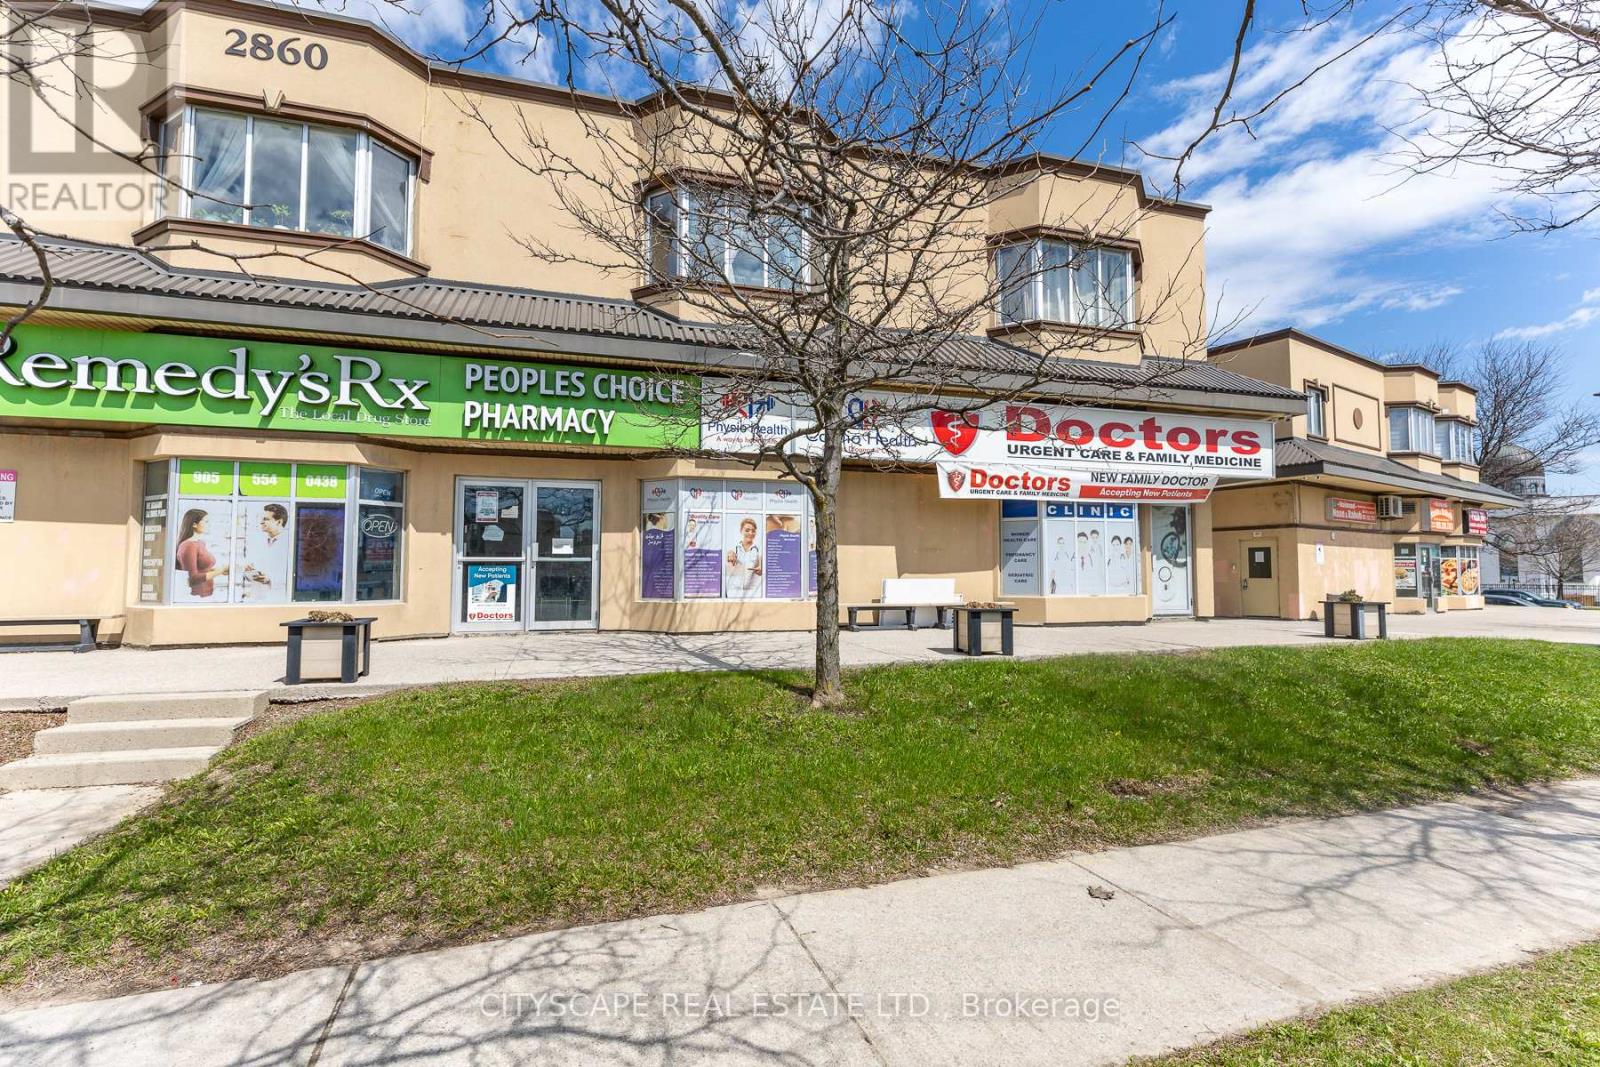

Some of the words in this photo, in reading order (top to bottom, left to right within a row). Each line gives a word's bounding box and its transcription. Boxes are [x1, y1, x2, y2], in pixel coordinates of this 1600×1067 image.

[225, 28, 328, 70] 2860
[465, 363, 585, 397] PEOPLES
[593, 374, 684, 404] CHOICE
[280, 407, 307, 419] The
[313, 409, 350, 421] Local
[357, 411, 390, 428] Drug
[395, 413, 432, 426] Store
[464, 401, 615, 434] PHARMACY
[708, 422, 747, 435] Physio
[1006, 406, 1261, 455] Doctors
[1008, 444, 1075, 458] URGENT
[1080, 448, 1121, 461] CARE
[1125, 451, 1135, 461] &
[1139, 452, 1190, 464] FAMILY
[1194, 455, 1261, 468] MEDICINE
[193, 471, 220, 484] 905
[252, 473, 278, 486] 554
[305, 475, 338, 488] 0438
[970, 468, 1071, 491] Doctors
[1091, 472, 1118, 484] NEW
[1120, 474, 1160, 485] FAMILY
[1162, 475, 1208, 487] DOCTOR
[374, 487, 392, 496] OPEN
[1100, 487, 1142, 498] Accepting
[1143, 489, 1160, 498] New
[1161, 490, 1192, 498] Patients
[1048, 505, 1130, 516] CLINIC
[362, 520, 394, 532] OPEN
[478, 565, 507, 573] Accepting
